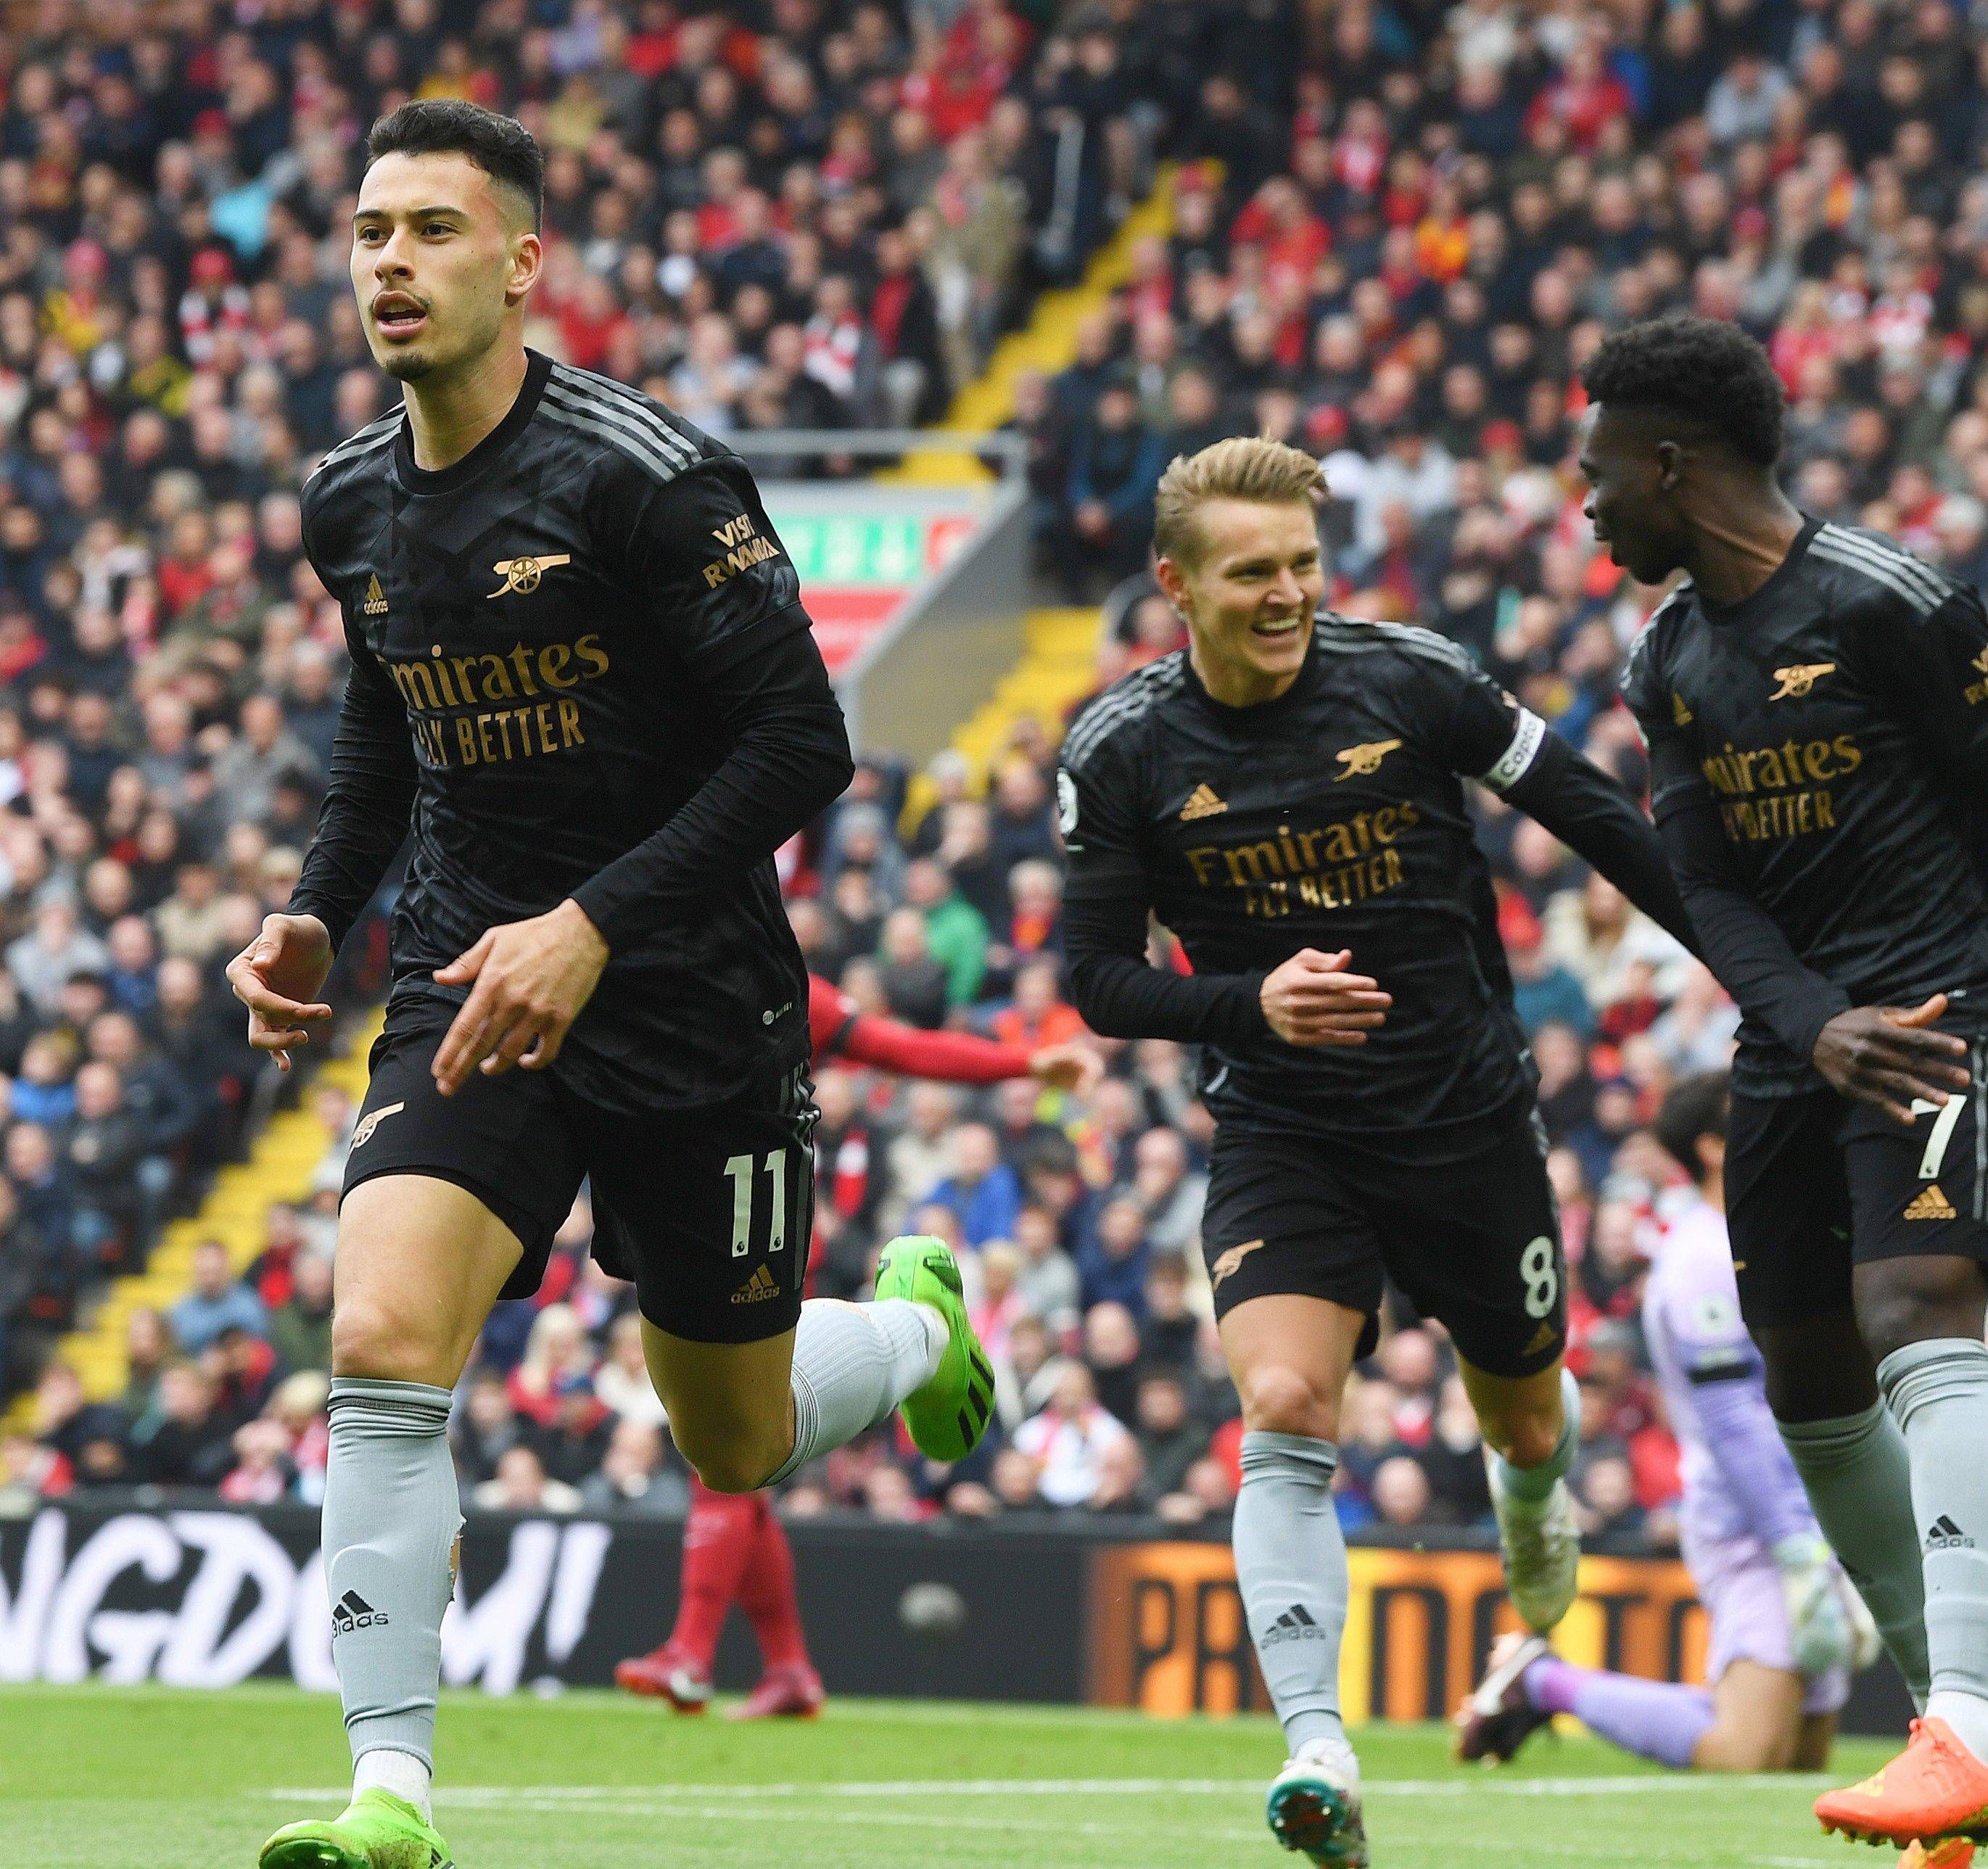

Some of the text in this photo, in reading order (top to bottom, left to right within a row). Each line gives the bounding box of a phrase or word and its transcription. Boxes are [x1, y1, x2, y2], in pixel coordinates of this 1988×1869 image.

[363, 599, 389, 615] adidas
[375, 634, 610, 709] mirates
[455, 698, 585, 765] BETTER
[1911, 1094, 1968, 1179] 7
[724, 1147, 787, 1258] 11
[731, 1286, 780, 1304] adidas
[1519, 1235, 1558, 1319] 8
